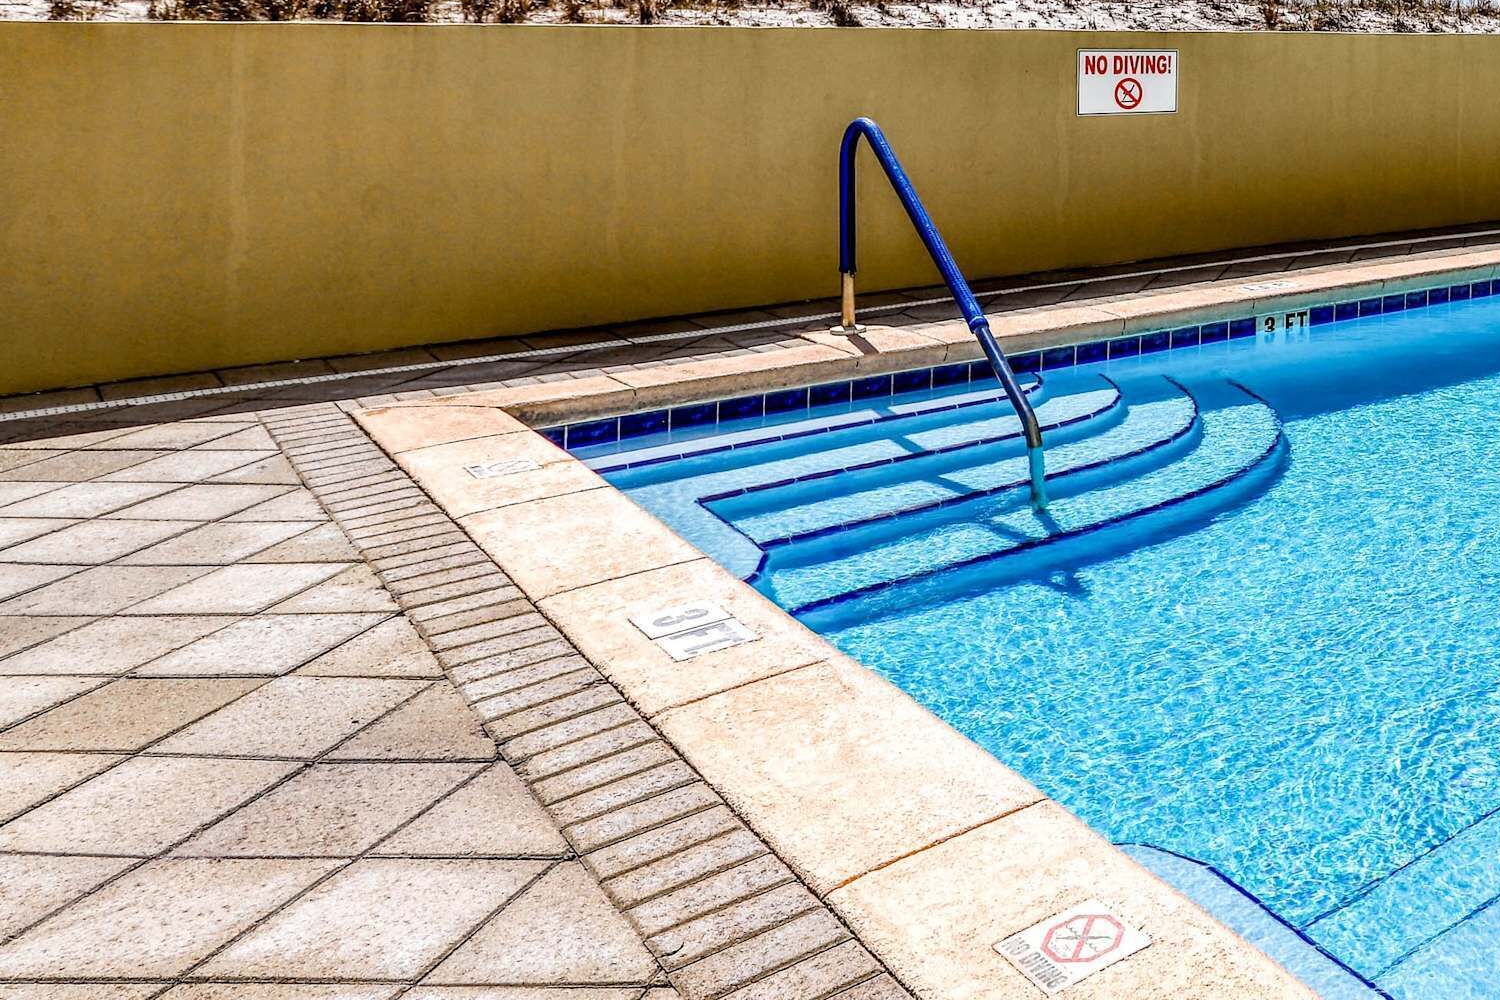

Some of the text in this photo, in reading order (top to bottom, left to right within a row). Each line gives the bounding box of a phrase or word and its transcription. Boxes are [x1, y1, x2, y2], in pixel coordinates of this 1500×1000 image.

[1085, 55, 1172, 75] NO DIVING!
[1264, 310, 1308, 332] 3 FT
[1002, 937, 1068, 989] NO DIVING
